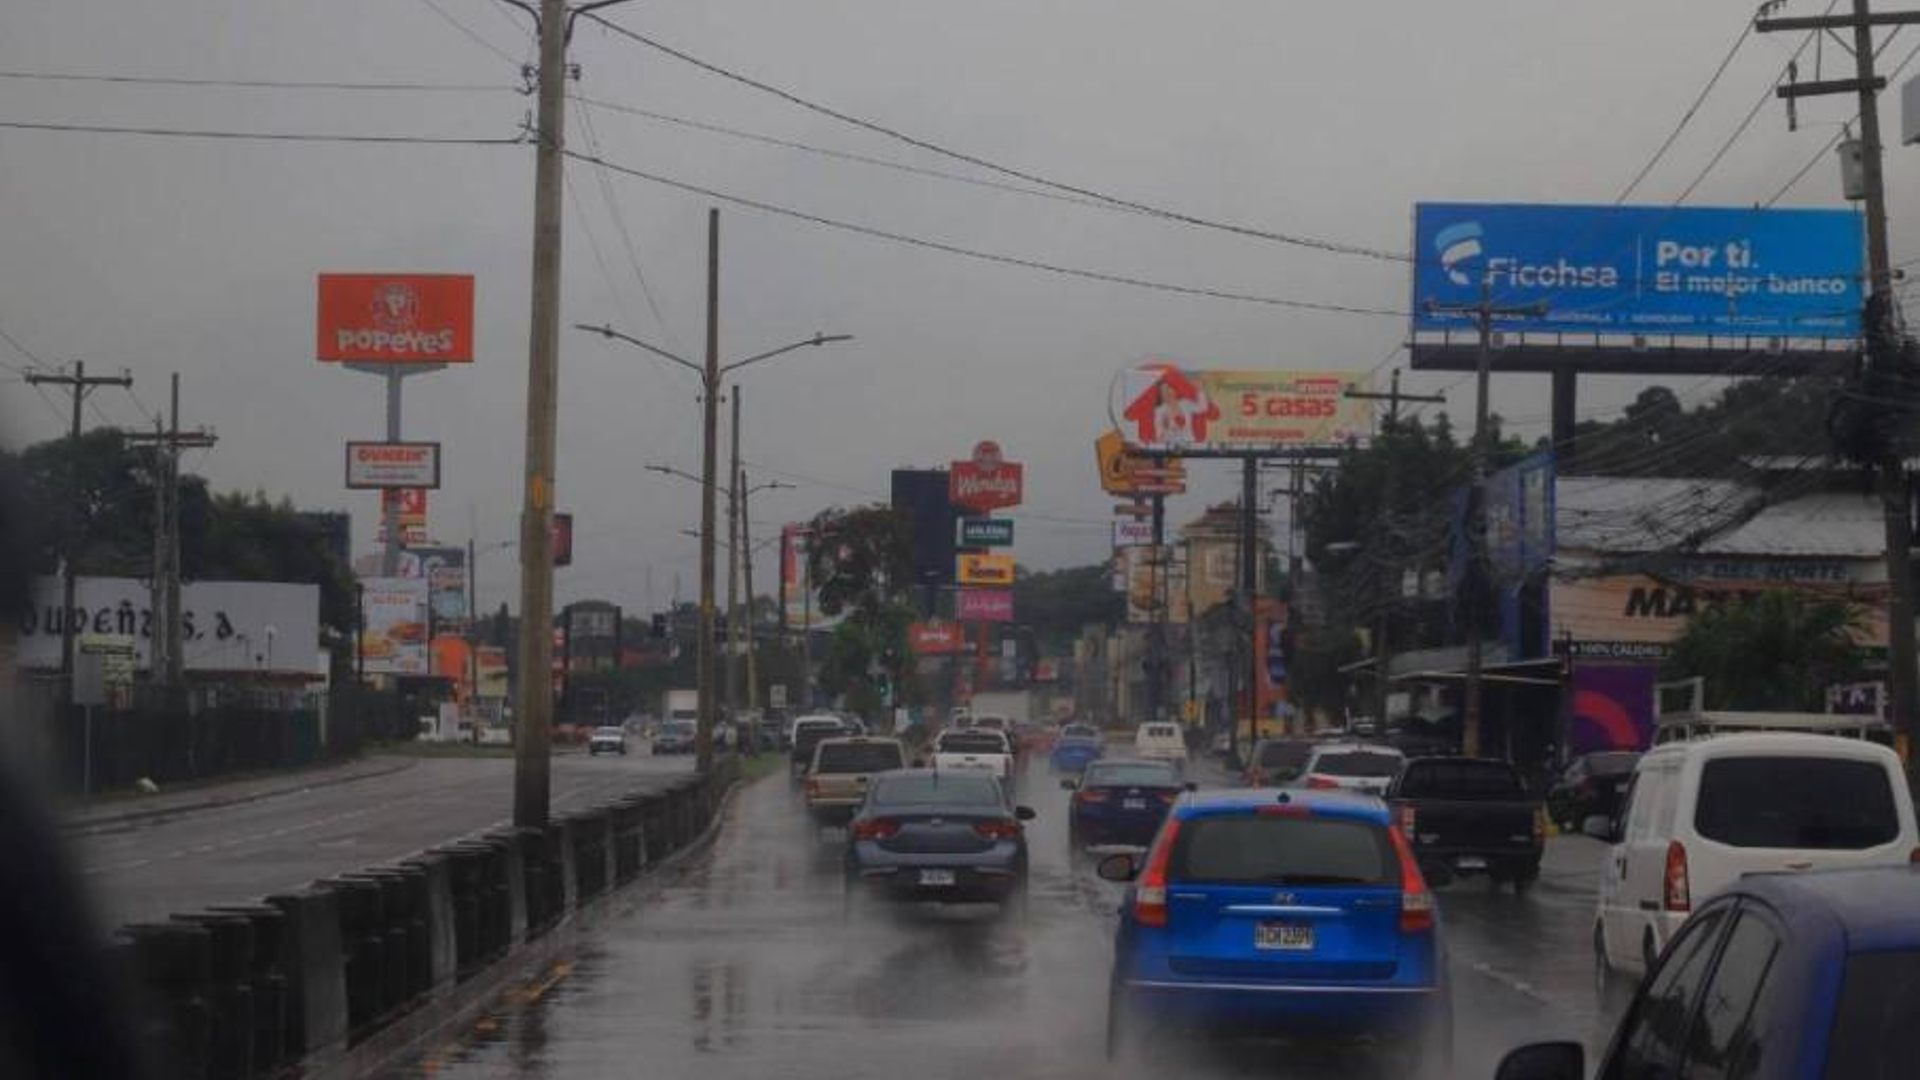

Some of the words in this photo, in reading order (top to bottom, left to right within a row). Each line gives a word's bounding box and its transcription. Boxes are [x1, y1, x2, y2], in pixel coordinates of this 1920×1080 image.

[1657, 241, 1716, 268] Por
[1726, 239, 1760, 268] ti.
[1485, 257, 1618, 287] Ficohsa
[1656, 272, 1680, 291] El
[1768, 273, 1847, 294] banco
[1242, 393, 1257, 416] 5
[1267, 398, 1336, 417] casas
